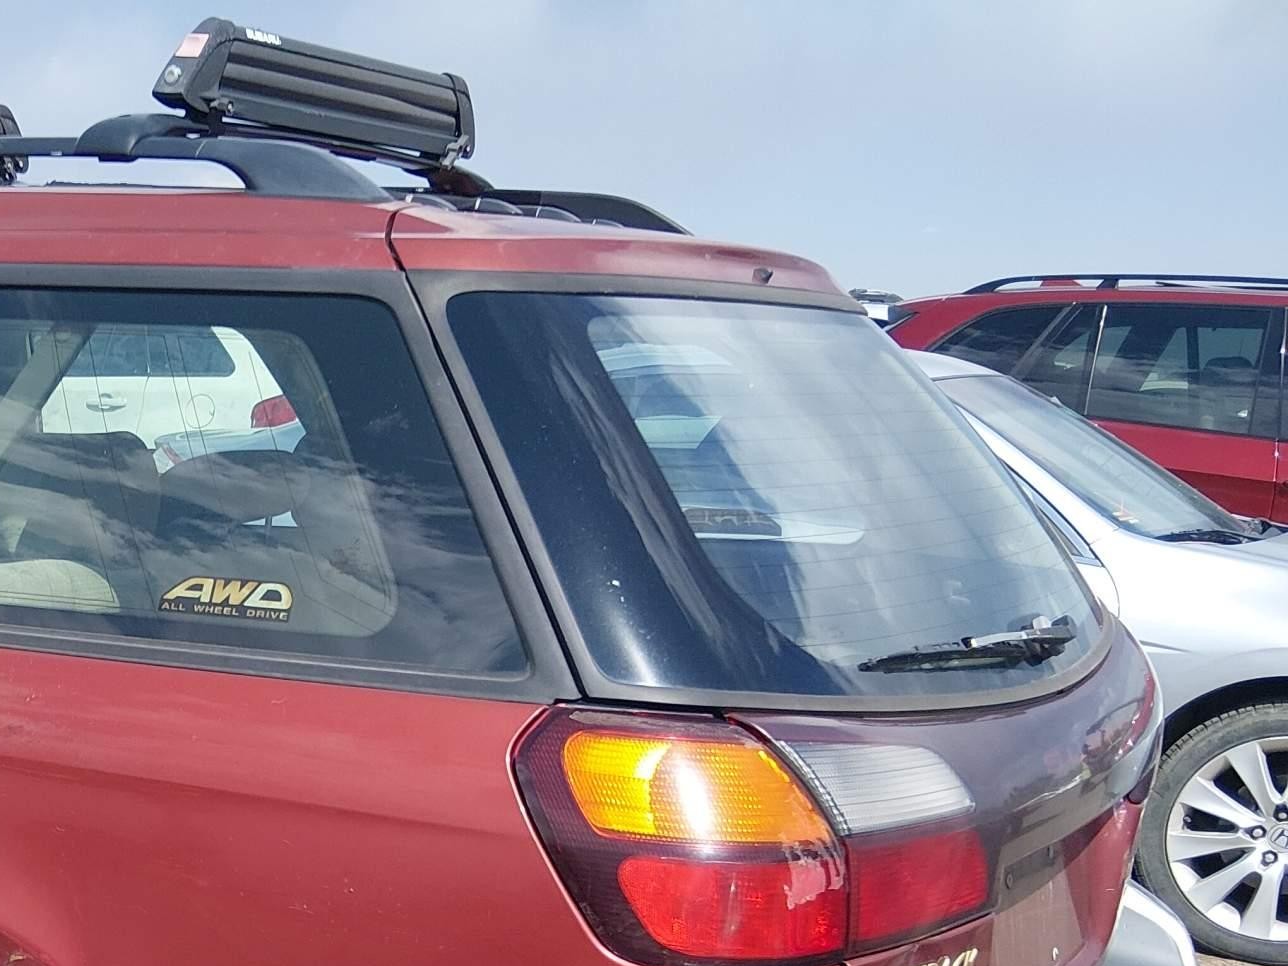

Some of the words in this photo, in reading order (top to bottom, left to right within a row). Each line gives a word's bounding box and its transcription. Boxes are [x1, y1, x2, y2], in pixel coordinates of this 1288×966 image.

[162, 577, 293, 610] AWD
[161, 602, 186, 611] ALL
[193, 604, 240, 616] WHEEL
[246, 608, 289, 621] DRIVE
